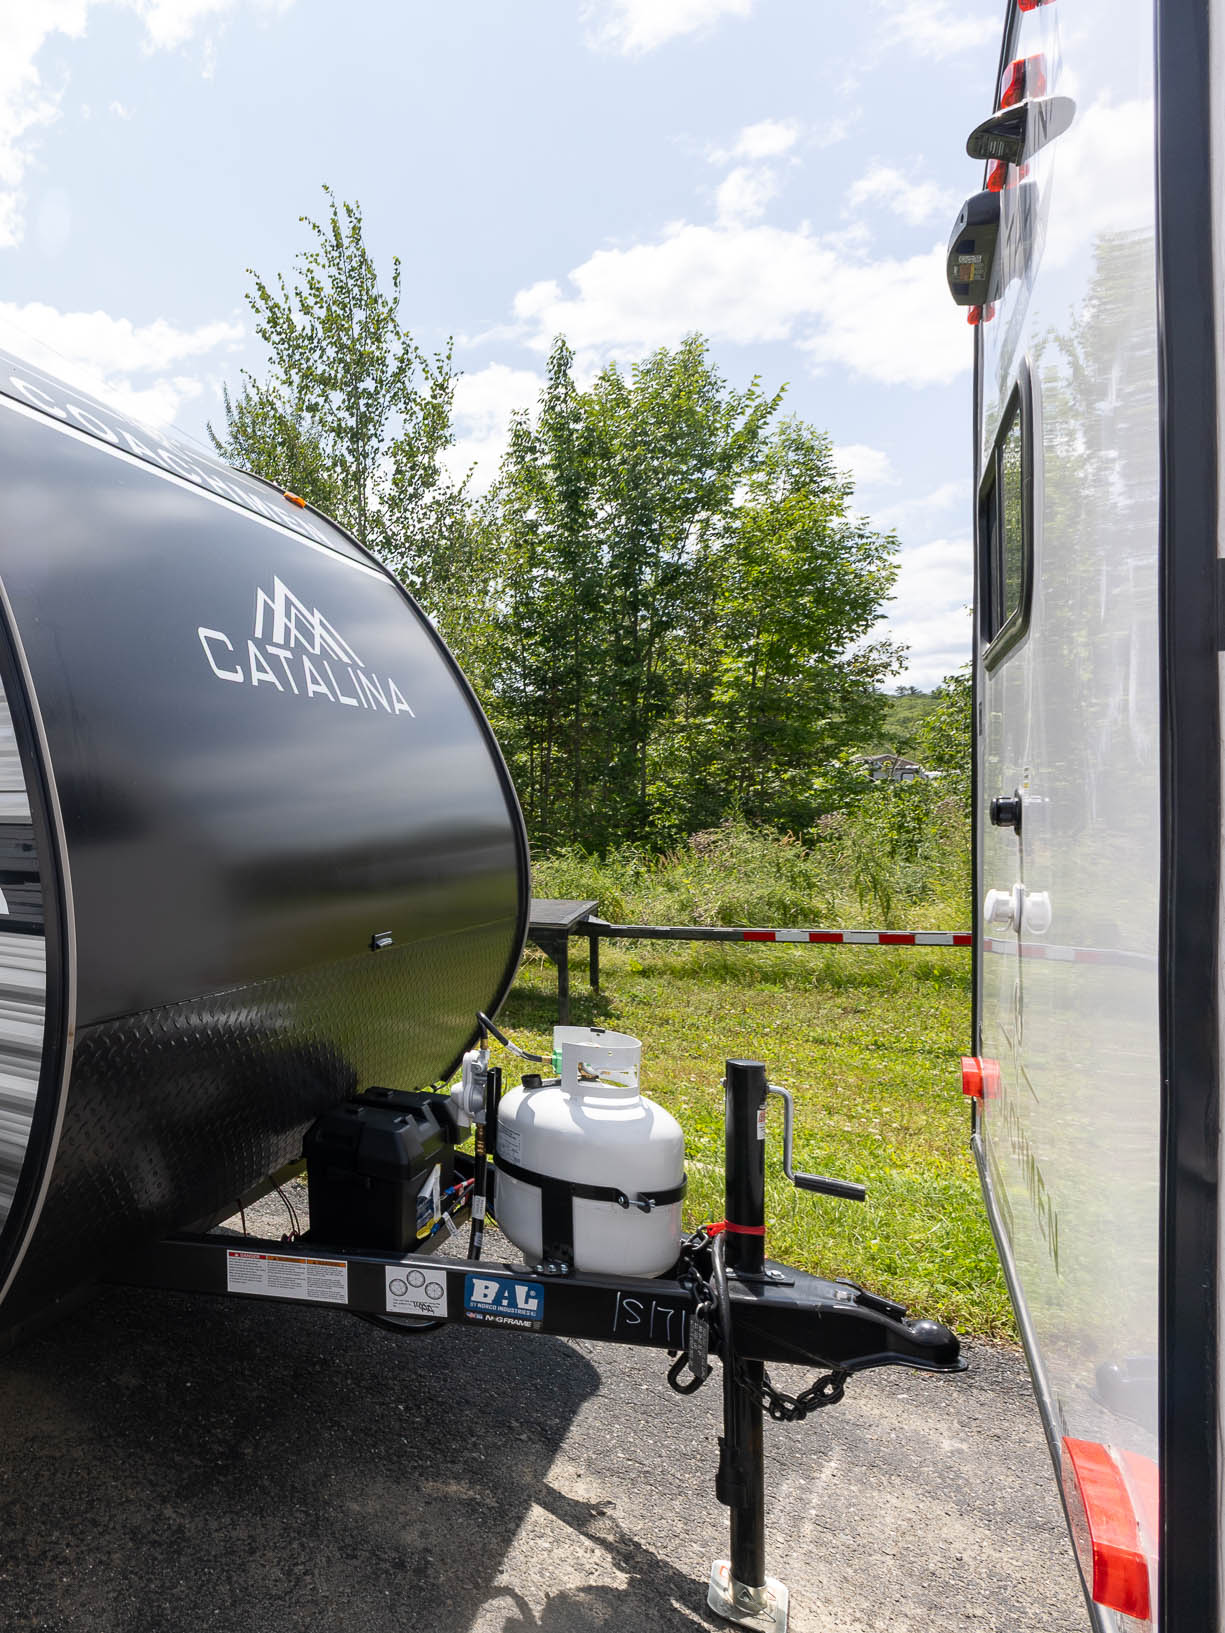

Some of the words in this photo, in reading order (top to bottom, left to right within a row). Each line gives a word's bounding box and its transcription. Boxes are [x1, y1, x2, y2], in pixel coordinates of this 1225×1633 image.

[9, 376, 337, 548] COACHMEN
[197, 627, 416, 718] CATALINA
[470, 1278, 539, 1311] BAL
[477, 1302, 497, 1311] NORCO
[498, 1305, 530, 1316] INDUSTRIES
